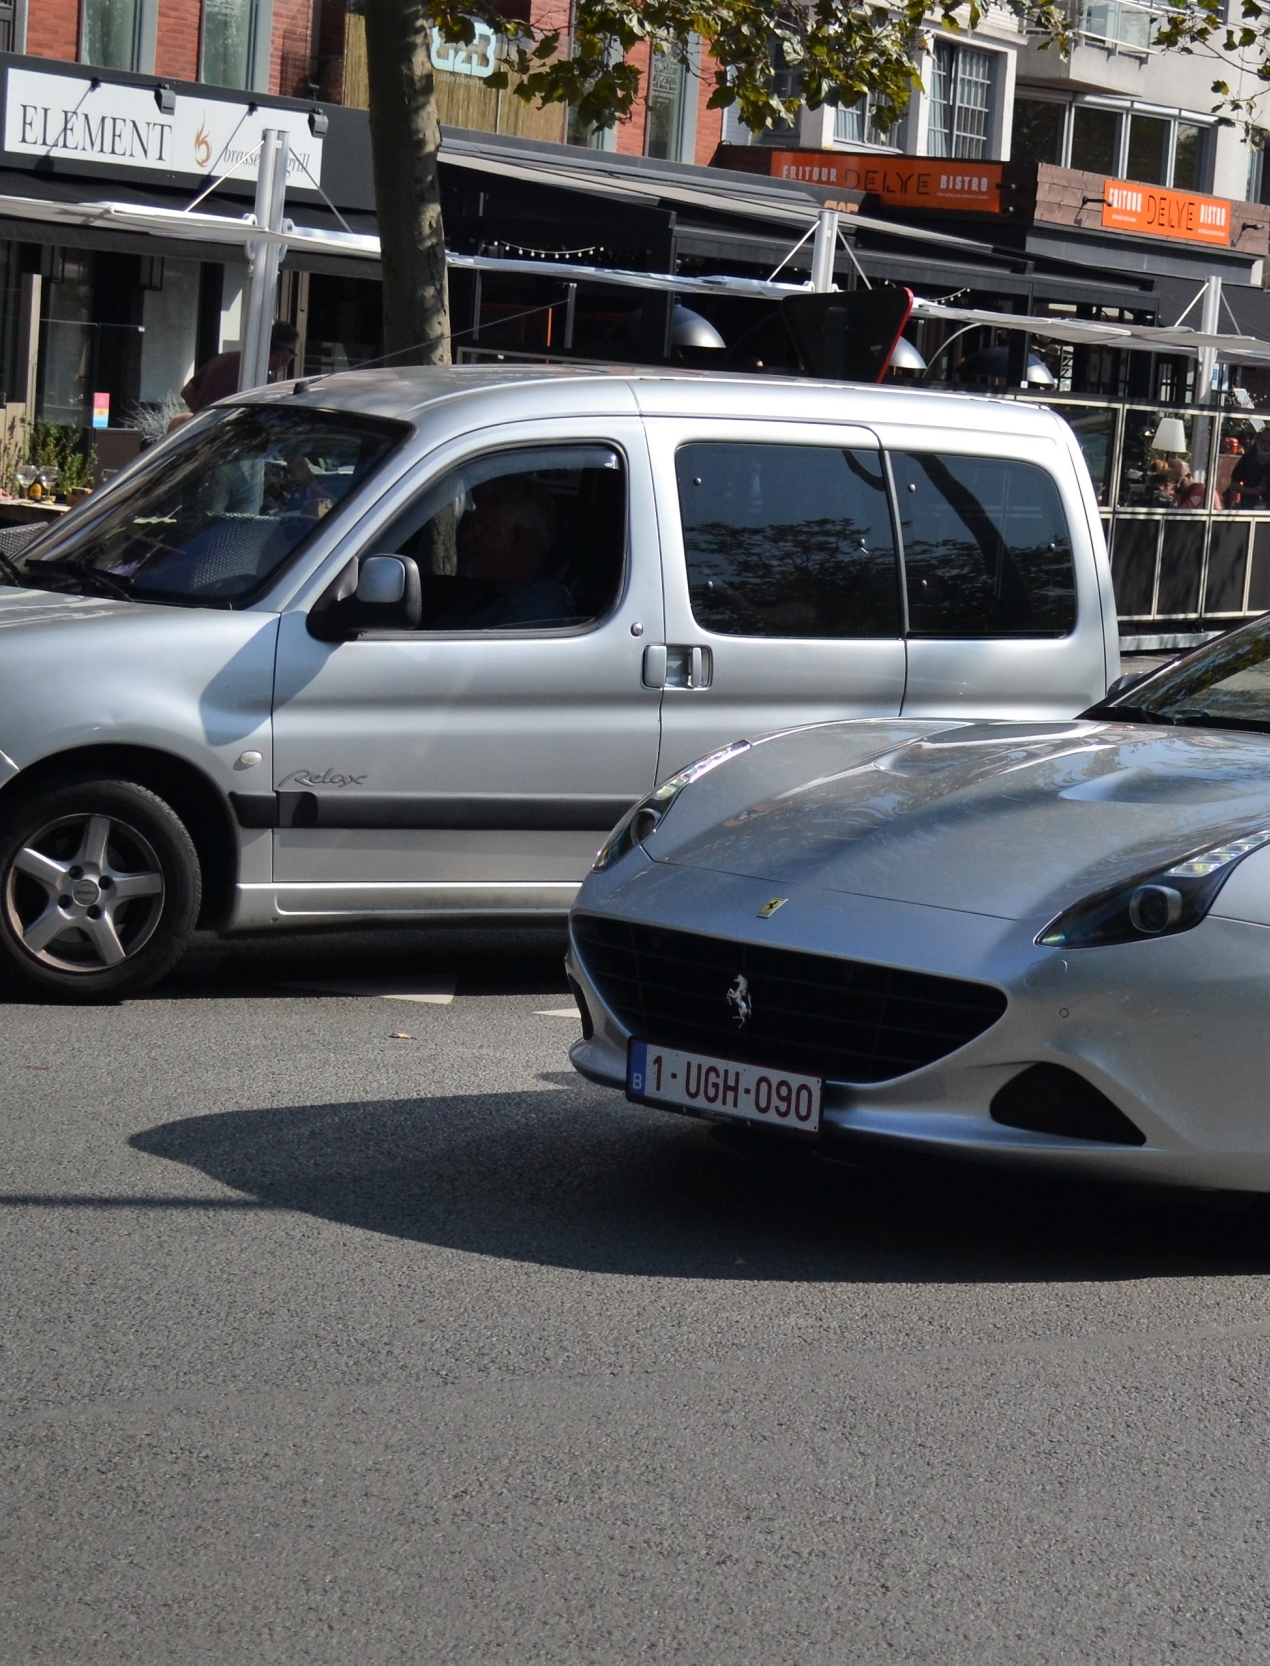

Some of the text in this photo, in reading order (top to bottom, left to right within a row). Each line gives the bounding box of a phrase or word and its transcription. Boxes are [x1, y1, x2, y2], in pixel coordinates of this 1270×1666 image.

[18, 103, 172, 162] ELEMENT
[782, 164, 837, 183] FRITUUR
[844, 168, 931, 196] DELYE
[940, 174, 988, 192] BISTRO
[1109, 187, 1226, 231] FRITUUR DELYE BISTRO
[278, 767, 369, 788] Relax
[632, 1054, 813, 1122] B 1-UGH-090
